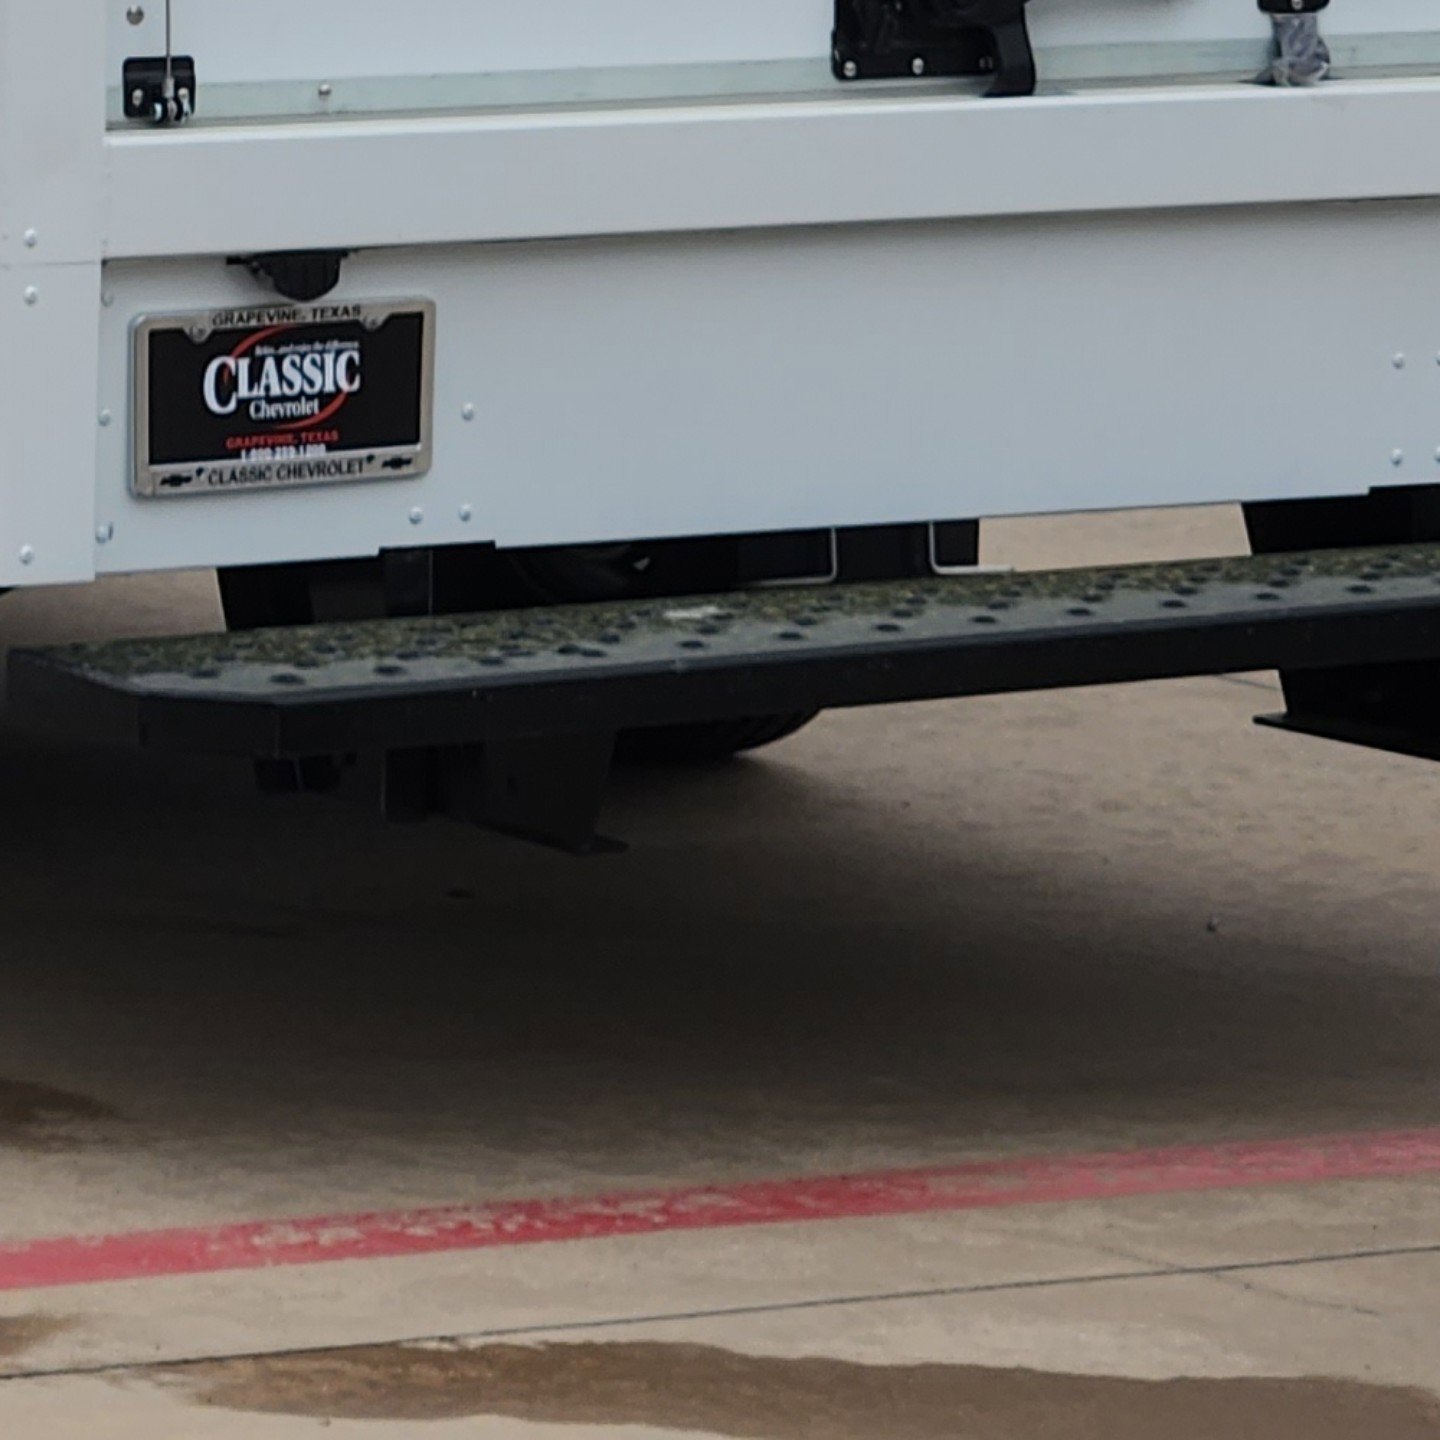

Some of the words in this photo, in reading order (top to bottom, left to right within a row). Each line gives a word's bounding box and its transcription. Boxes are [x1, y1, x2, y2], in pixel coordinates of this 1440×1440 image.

[311, 303, 362, 319] TEXAS
[202, 350, 361, 415] CLASSIC
[248, 396, 320, 421] Chevrolet
[300, 429, 340, 444] TEXAS
[207, 464, 273, 486] CLASSIC
[275, 458, 365, 481] CHEVROLET
